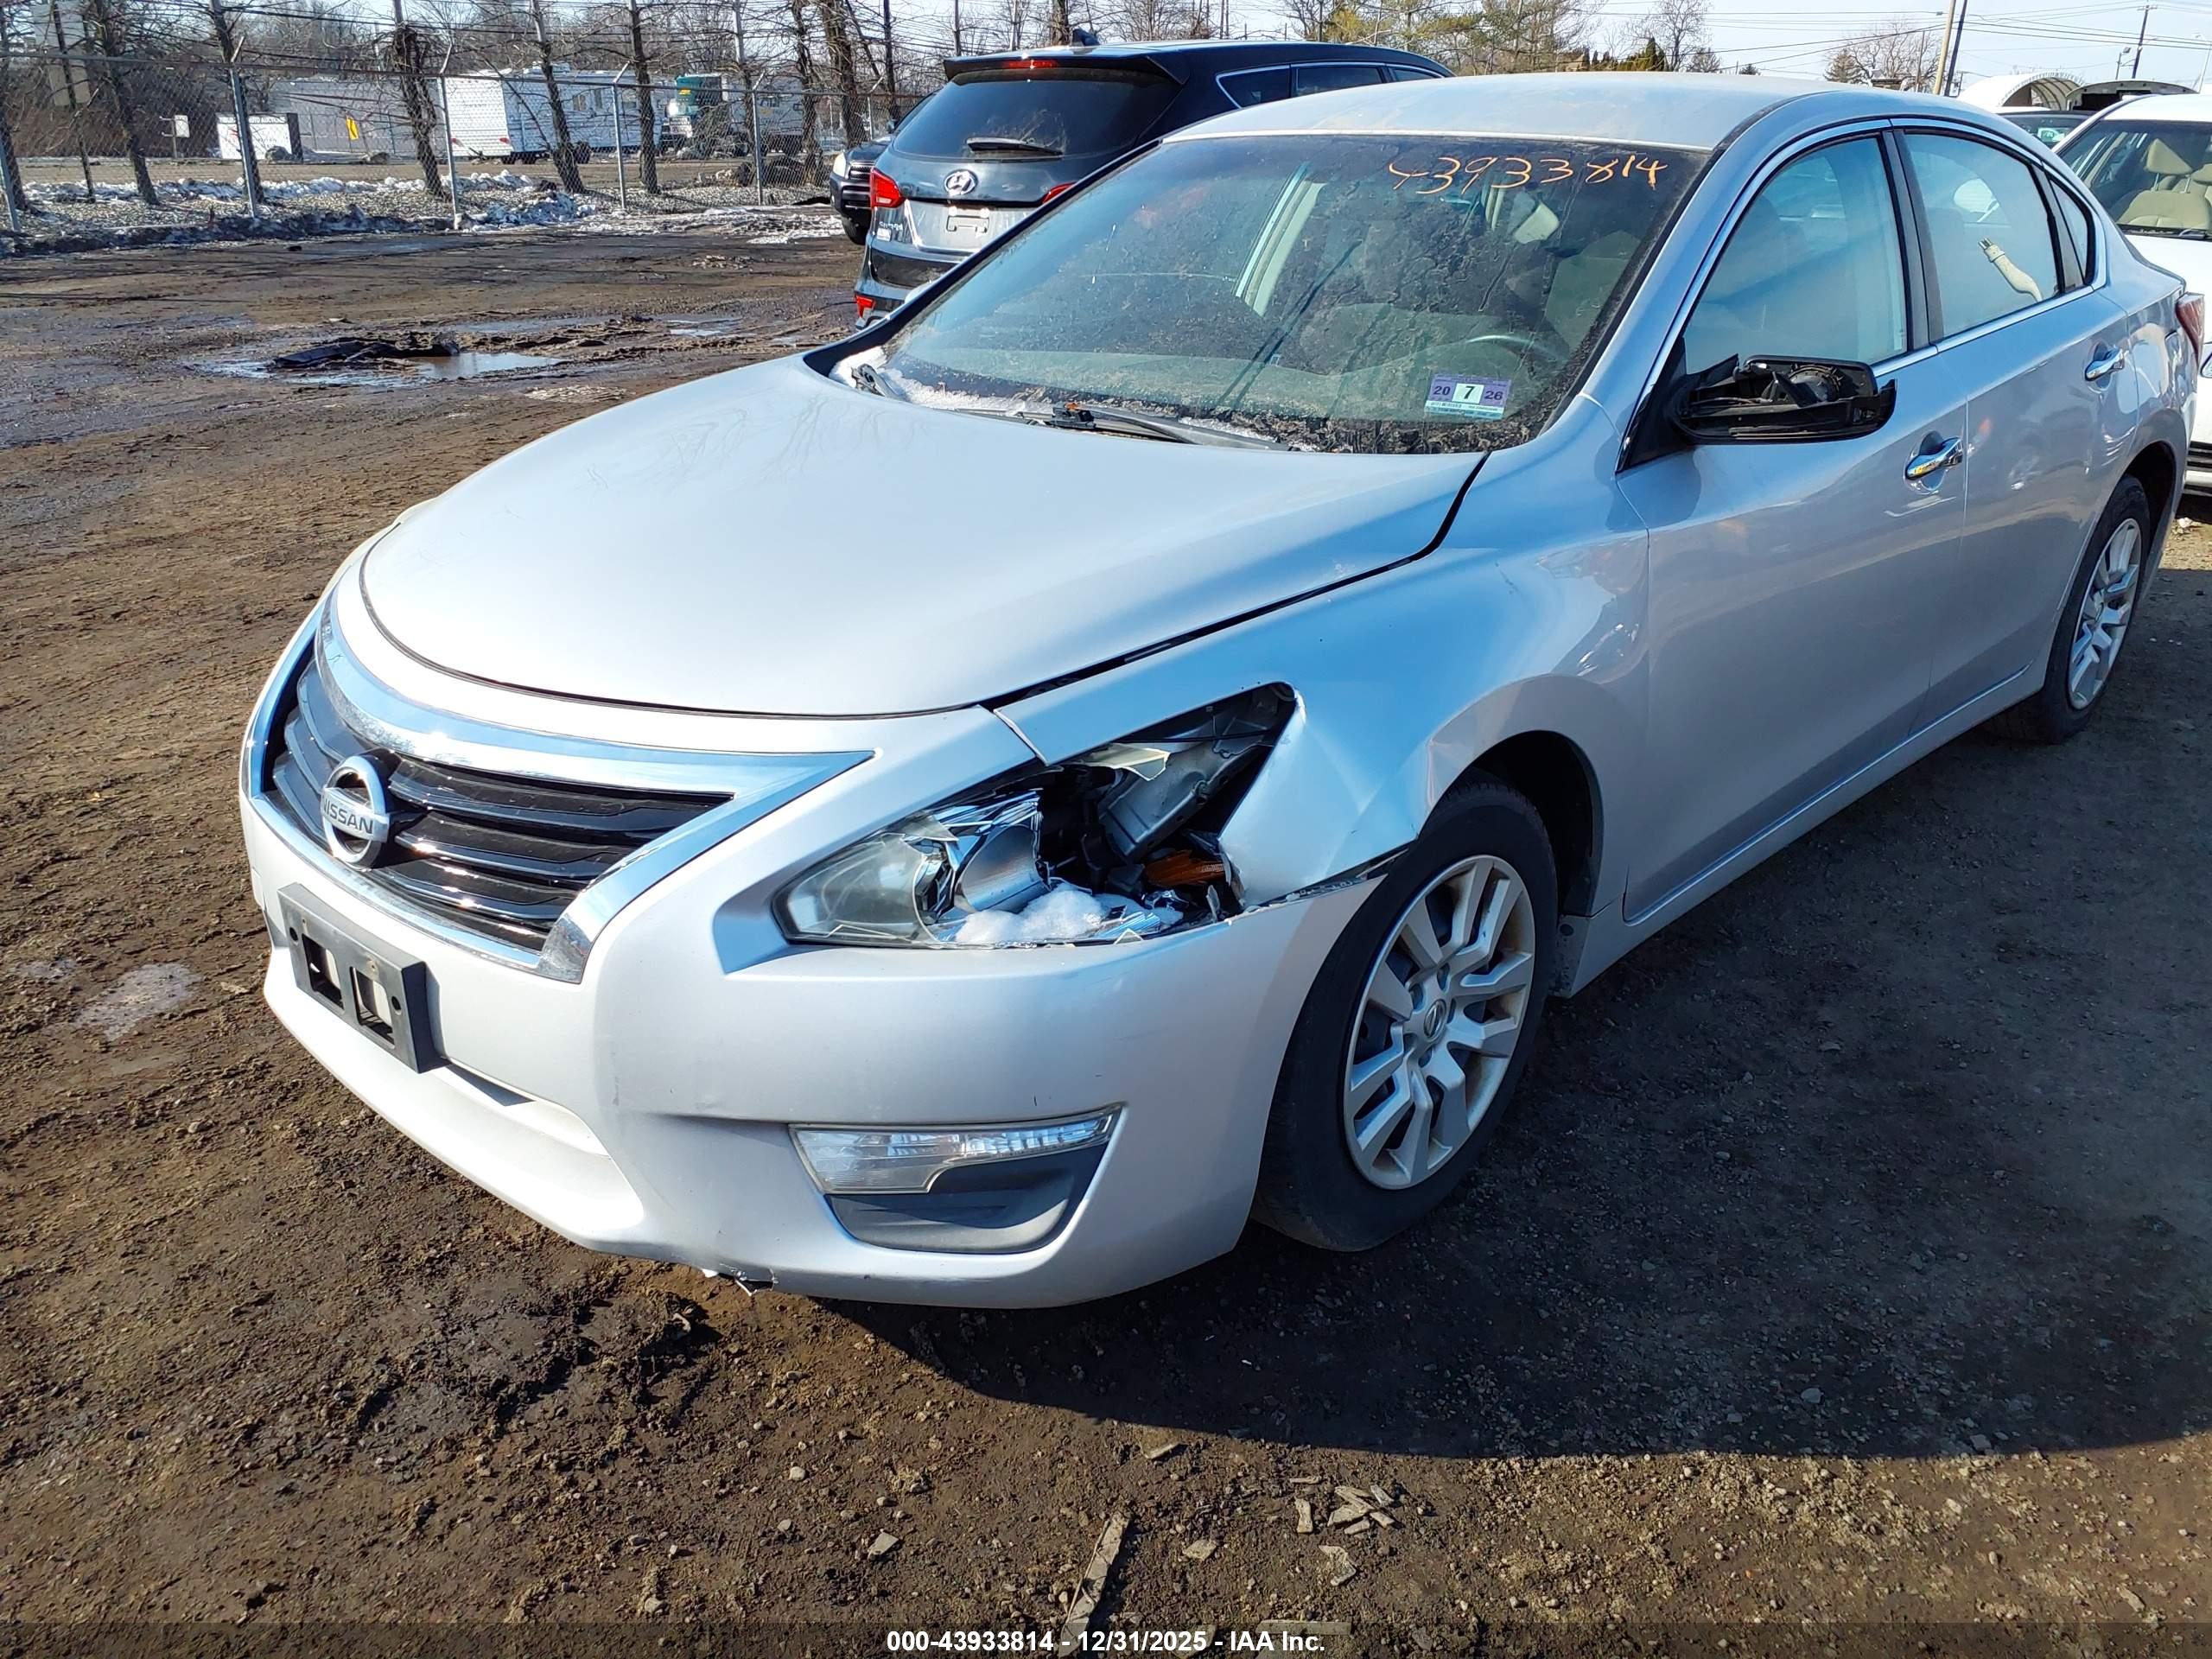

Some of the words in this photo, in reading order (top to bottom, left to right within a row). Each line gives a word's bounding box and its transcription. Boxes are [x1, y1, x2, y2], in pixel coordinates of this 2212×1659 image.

[1388, 154, 1669, 195] 43933814
[1433, 385, 1452, 396] 20
[1463, 385, 1475, 399] 7
[1484, 390, 1503, 401] 26
[322, 798, 374, 835] NISSAN
